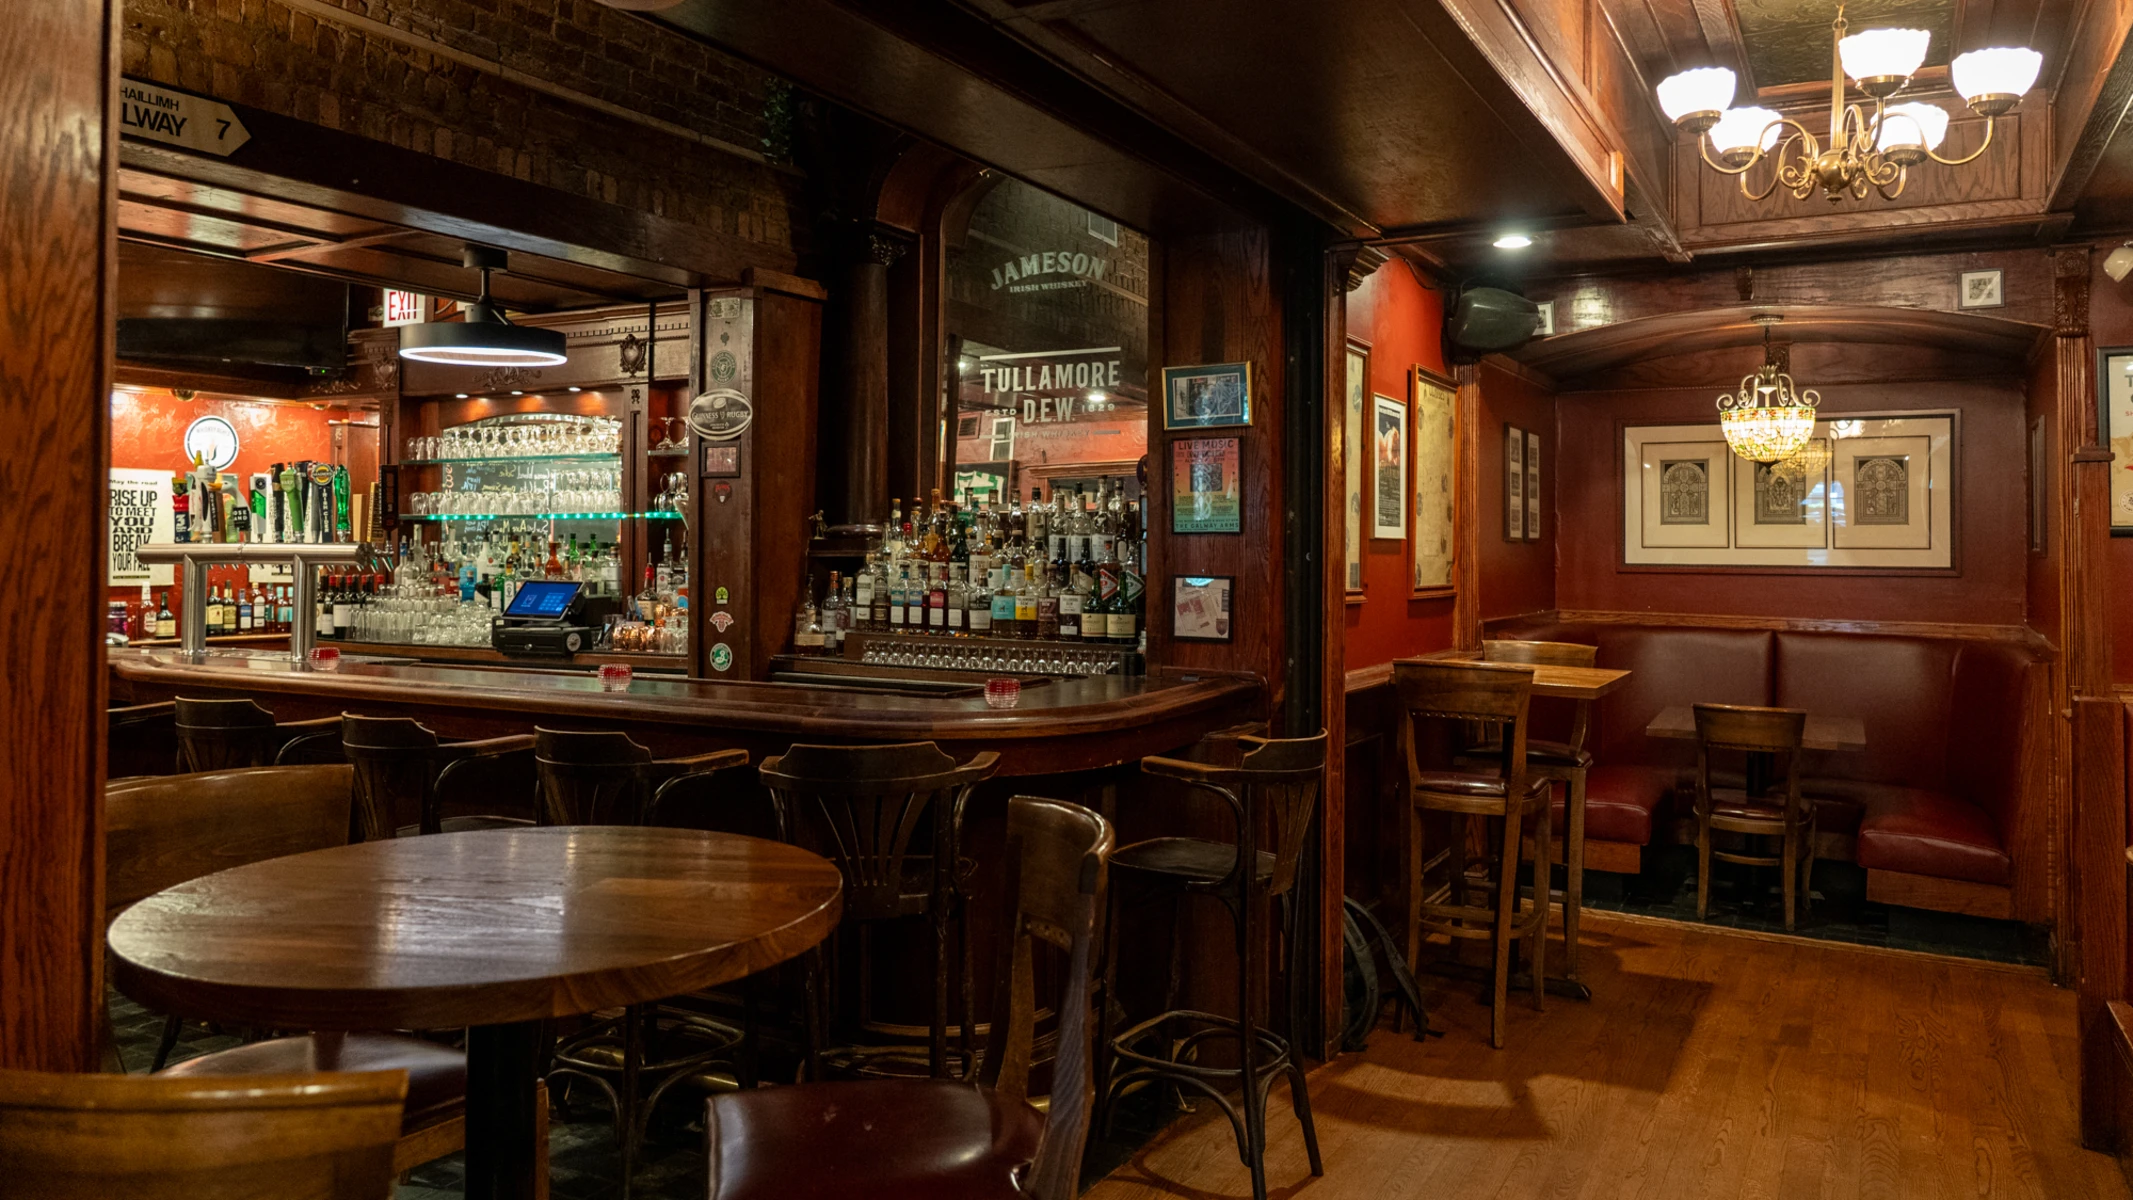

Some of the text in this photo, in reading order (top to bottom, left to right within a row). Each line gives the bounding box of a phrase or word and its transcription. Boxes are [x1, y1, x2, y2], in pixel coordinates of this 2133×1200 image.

[122, 102, 231, 140] LWAY 7
[991, 251, 1106, 290] JAMESON
[1009, 280, 1087, 293] IRISH WHISKEY
[388, 289, 417, 321] EXIT
[980, 361, 1120, 393] TULLAMORE
[691, 410, 748, 420] GUINNESS RUGBY
[1023, 396, 1076, 424] D.E.W.
[1081, 403, 1115, 414] 1829
[1178, 439, 1234, 450] LIVE MUSIC
[110, 489, 158, 507] RISE UP
[110, 506, 157, 517] TO MEET
[111, 516, 154, 527] YOU
[112, 526, 153, 534] AND
[112, 552, 132, 571] YOUR
